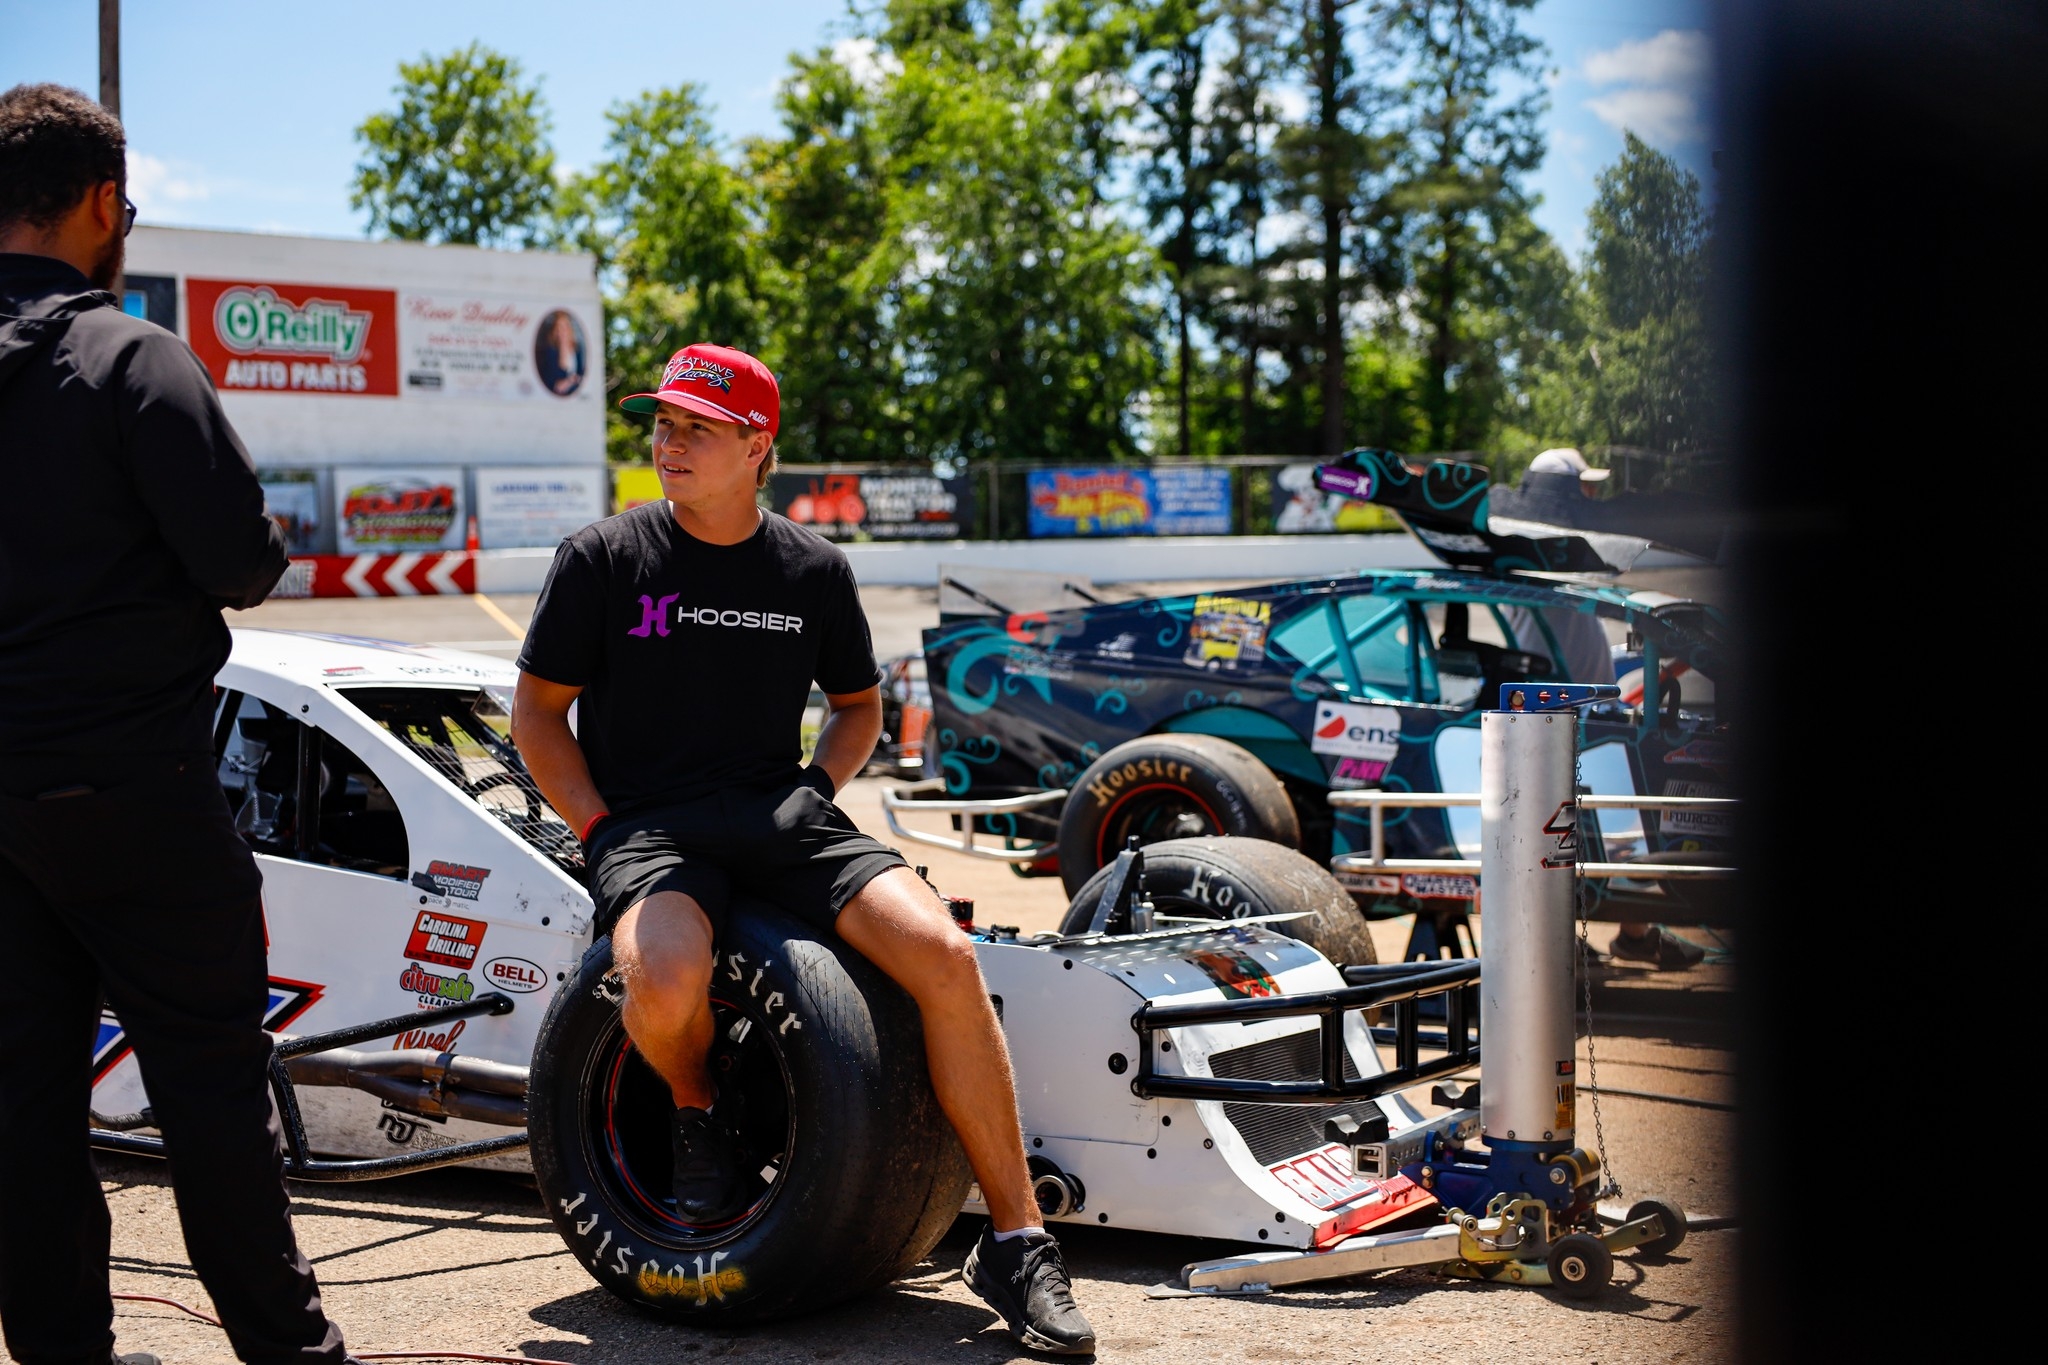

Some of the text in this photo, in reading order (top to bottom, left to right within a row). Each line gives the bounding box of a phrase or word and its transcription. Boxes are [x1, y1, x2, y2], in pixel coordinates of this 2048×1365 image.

[220, 292, 363, 356] O'Reilly
[224, 360, 367, 391] AUTO PARTS
[677, 606, 804, 634] HOOSIER
[1086, 753, 1194, 807] Hoosier
[428, 860, 491, 882] SMART
[433, 875, 481, 890] MODIFIED
[1404, 873, 1473, 888] QUARTER
[449, 887, 477, 899] TOUR
[1179, 866, 1254, 923] Hoo
[1415, 885, 1475, 897] MASTER
[417, 913, 469, 940] CAROLINA
[425, 933, 476, 960] DRILLING
[400, 962, 474, 1002] citrusafe
[493, 963, 539, 984] BELL
[498, 978, 533, 990] HELMETS
[560, 1192, 731, 1306] Hoosier
